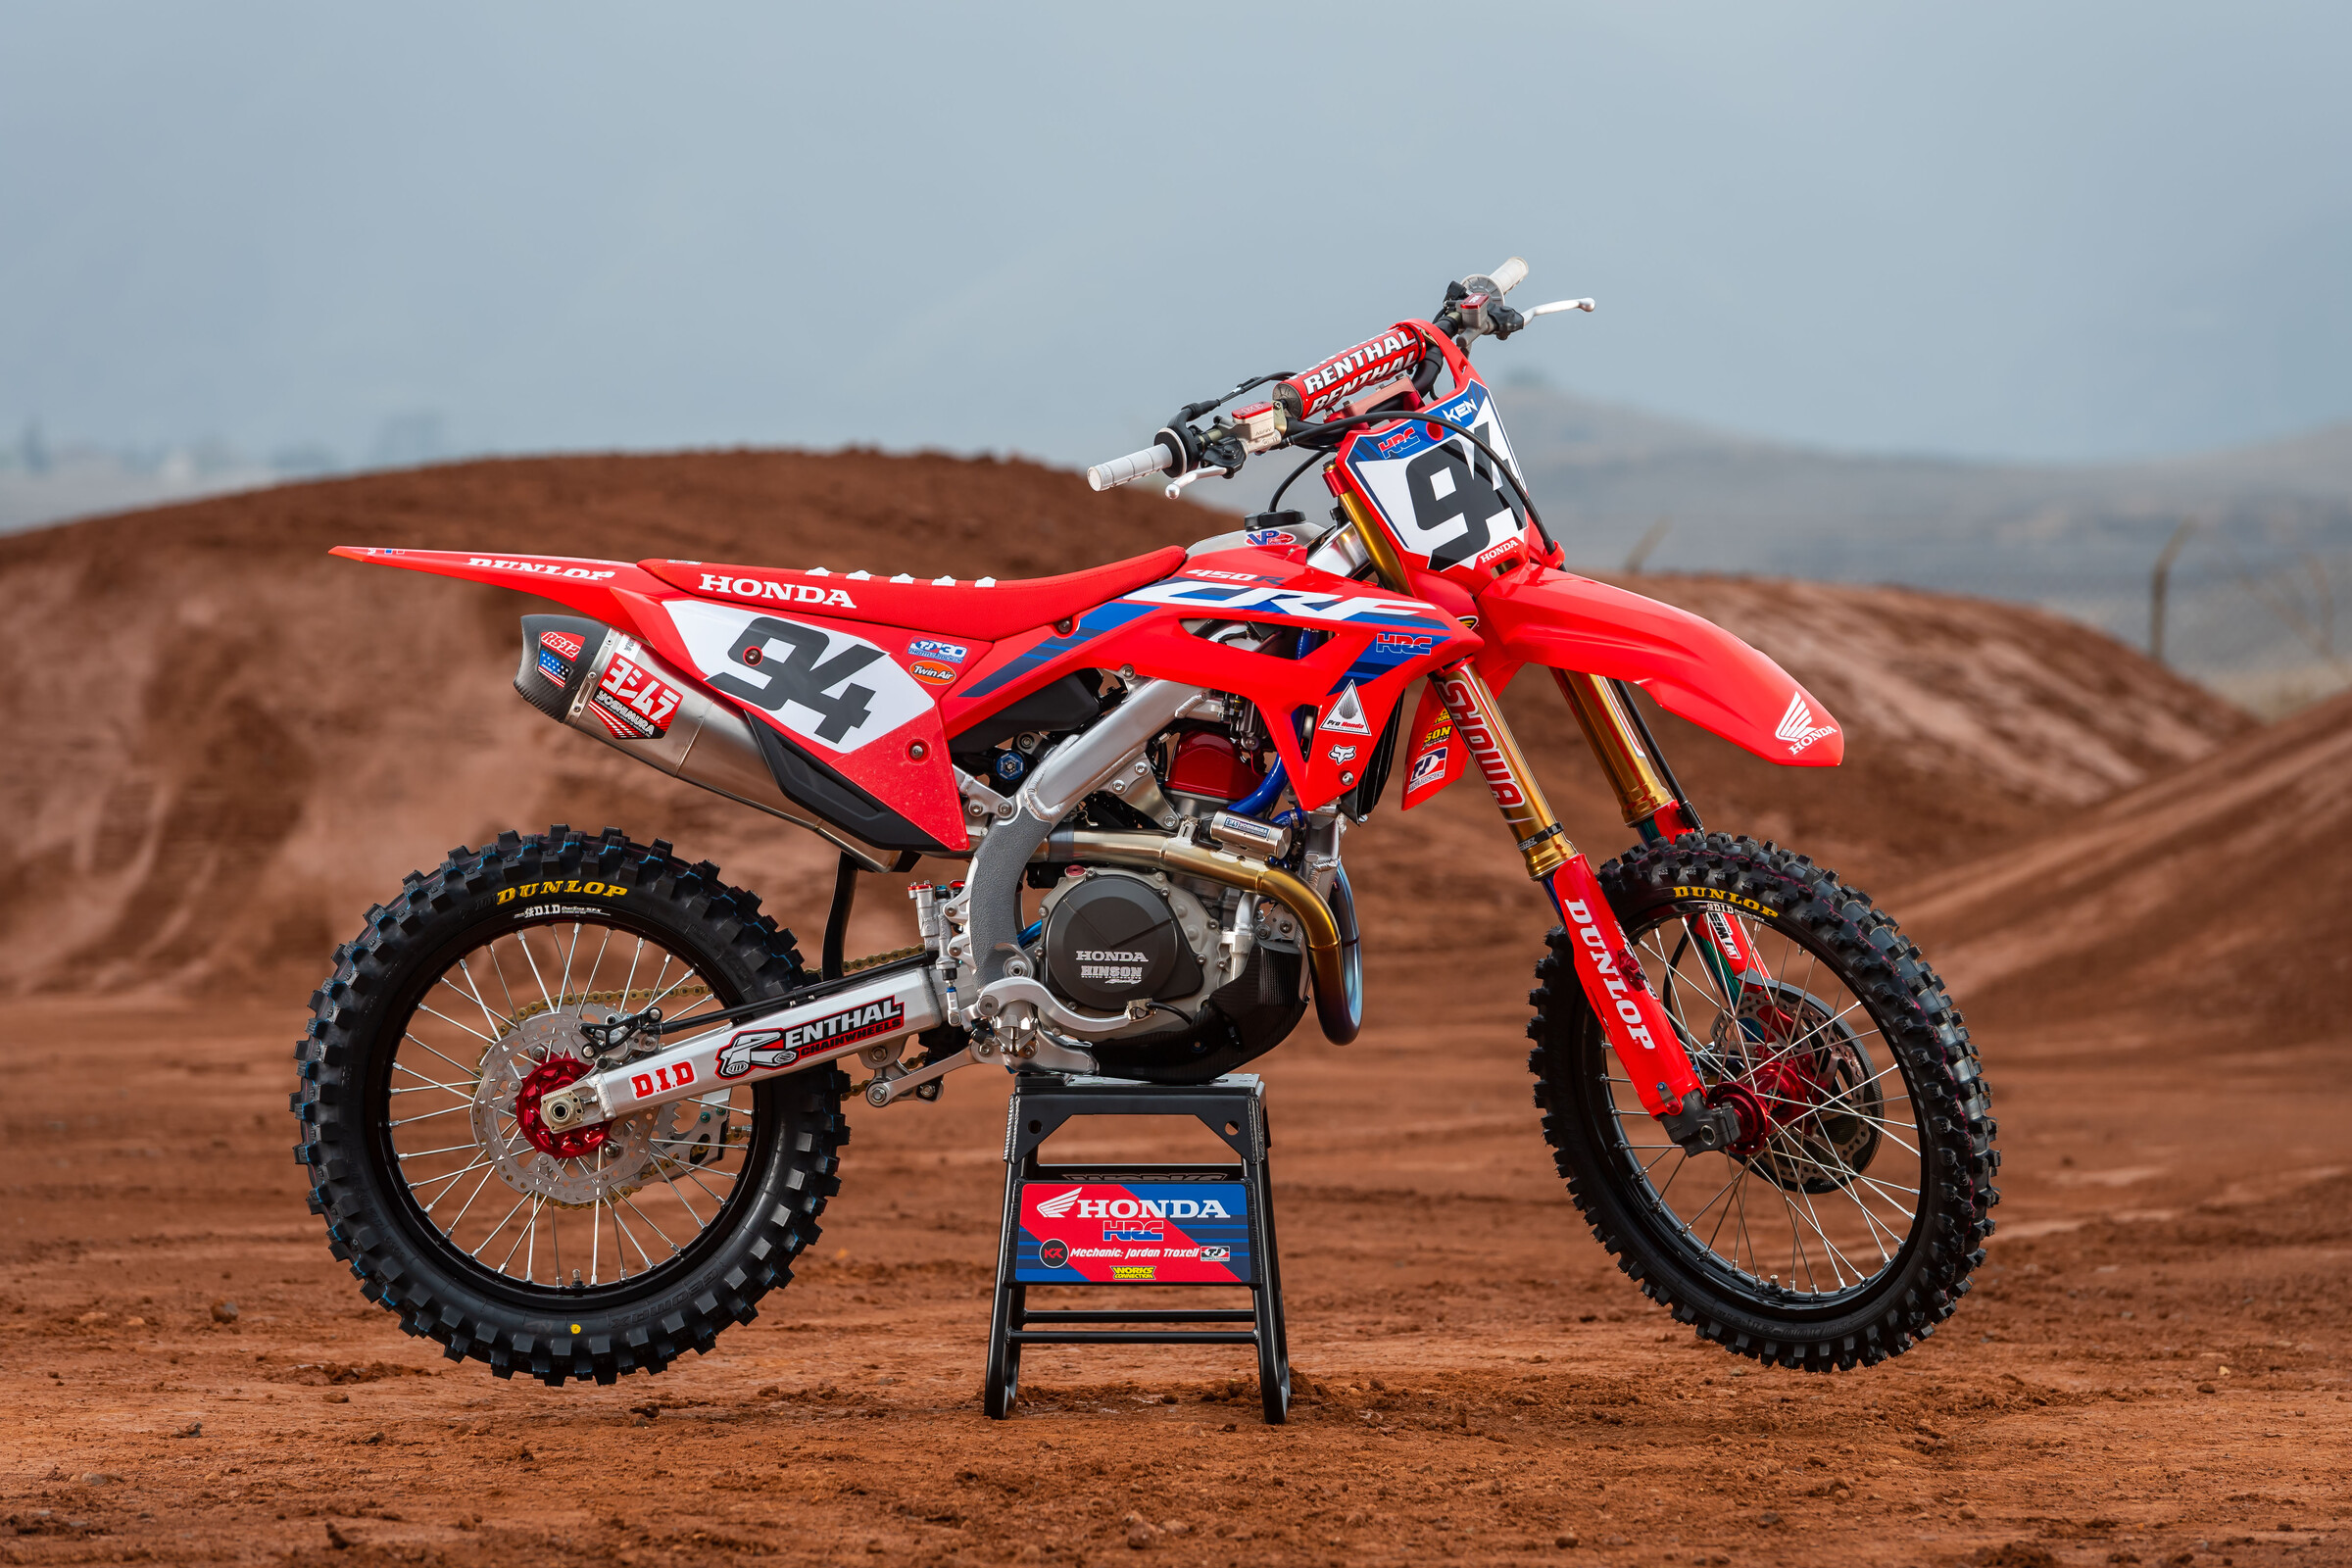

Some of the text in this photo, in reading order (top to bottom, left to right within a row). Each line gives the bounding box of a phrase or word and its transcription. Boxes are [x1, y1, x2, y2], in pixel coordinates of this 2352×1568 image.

[1302, 330, 1416, 395] RENTHAL
[1308, 351, 1416, 416] RENTHAL
[1442, 398, 1479, 422] KEN
[1378, 426, 1421, 459] HRC
[1479, 538, 1519, 564] HONDA
[467, 558, 616, 581] DUNLOP
[698, 573, 857, 609] HONDA
[1123, 579, 1437, 621] CRF
[1376, 634, 1432, 655] HRC
[703, 616, 888, 745] 94
[913, 664, 954, 681] Twin Air
[596, 690, 656, 736] YOSHIMURA
[1435, 679, 1526, 808] SHOWA
[1788, 725, 1838, 756] HONDA
[497, 880, 628, 906] DUNLOP
[1673, 886, 1779, 918] DUNLOP
[1075, 951, 1149, 962] HONDA
[1081, 965, 1143, 977] HINSON
[1564, 899, 1656, 1050] DUNLOP
[800, 1017, 902, 1057] CHAINWHEELS
[631, 1061, 695, 1099] D.I.D
[1077, 1199, 1231, 1219] HONDA
[1102, 1221, 1163, 1241] HRC
[1070, 1248, 1124, 1257] Mechanic:
[1124, 1248, 1161, 1259] Jordan
[1163, 1248, 1200, 1257] Troxell
